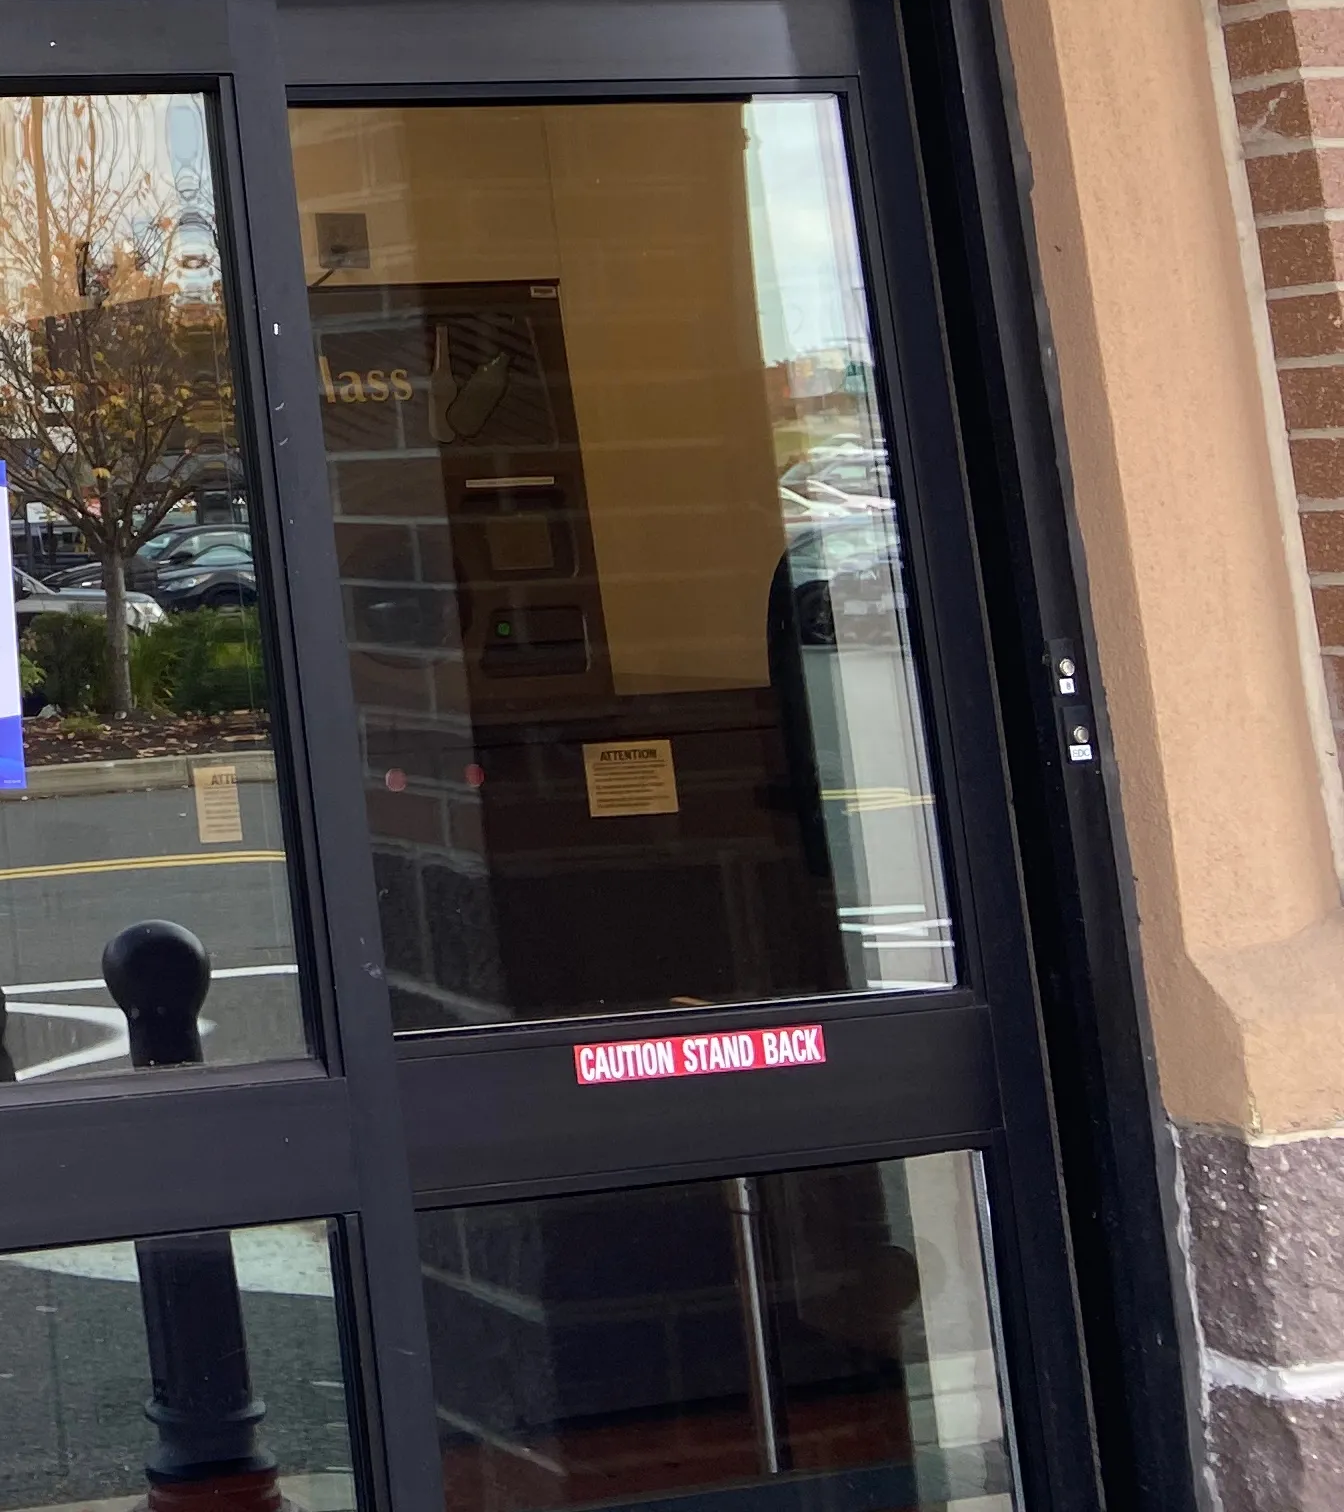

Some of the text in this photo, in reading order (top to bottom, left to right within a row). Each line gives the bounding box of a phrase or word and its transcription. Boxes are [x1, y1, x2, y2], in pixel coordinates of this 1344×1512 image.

[318, 355, 413, 403] lass
[600, 749, 657, 761] ATTENTION
[579, 1028, 821, 1081] CAUTION STAND BACK
